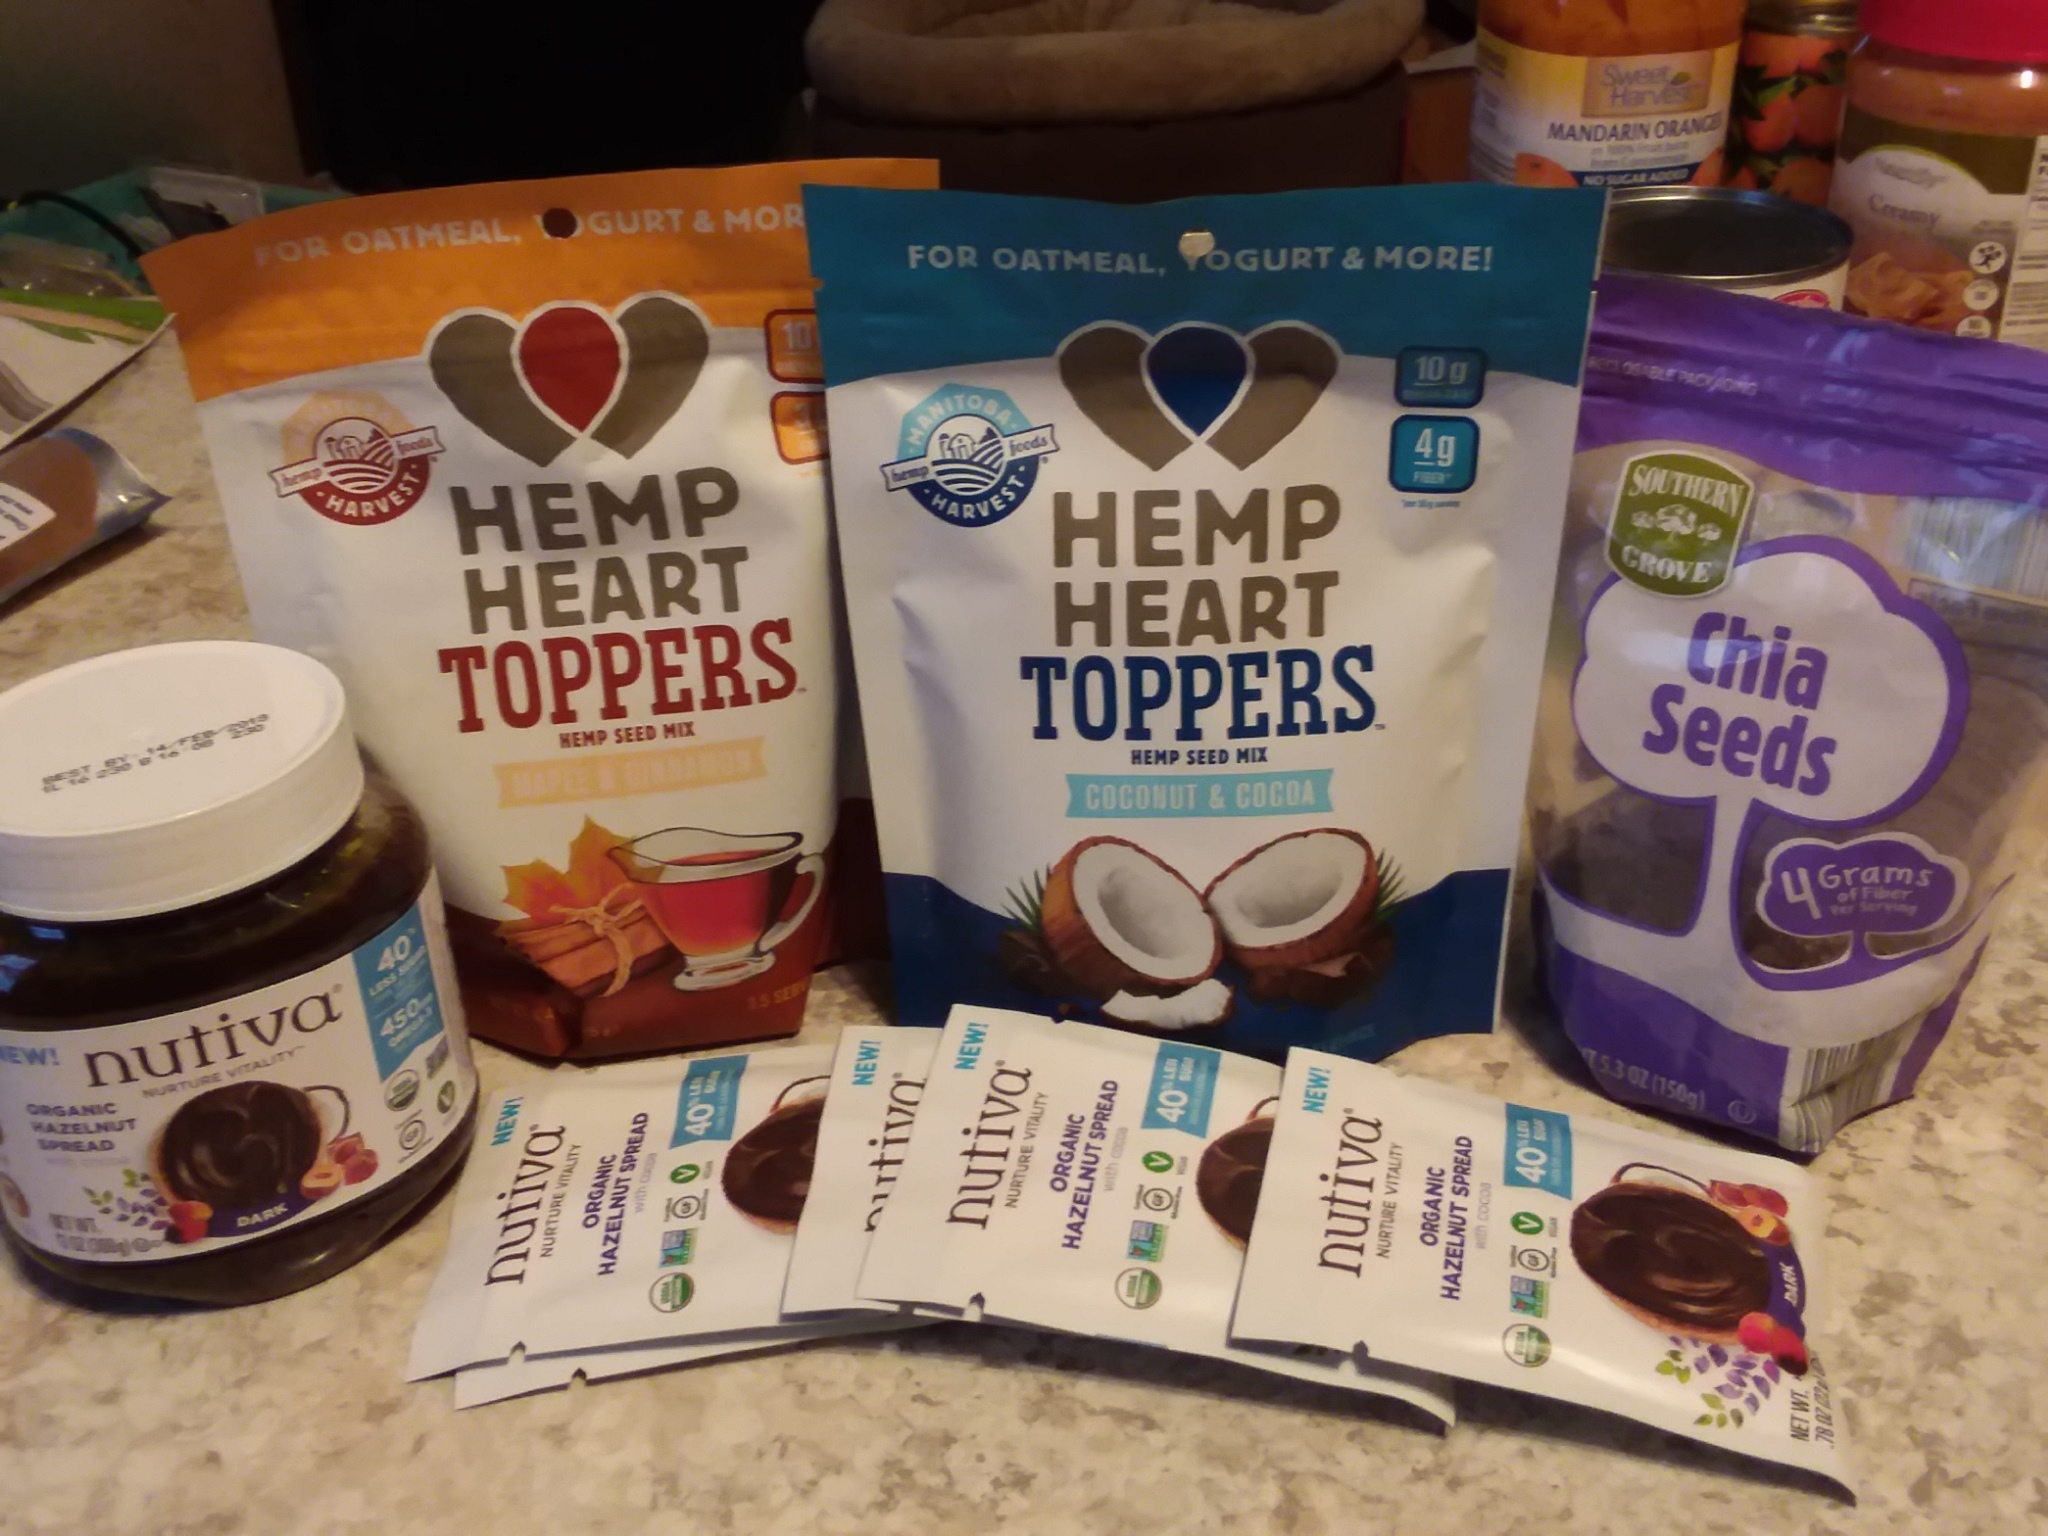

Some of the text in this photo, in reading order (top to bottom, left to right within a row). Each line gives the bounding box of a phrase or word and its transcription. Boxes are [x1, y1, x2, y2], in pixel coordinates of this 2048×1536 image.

[1603, 64, 1671, 86] Sweet
[1610, 83, 1699, 107] Harvest
[1547, 121, 1649, 142] MANDARIN
[255, 236, 331, 267] FOR
[342, 218, 521, 254] OATMEAL,
[693, 210, 716, 234] &
[908, 245, 978, 269] FOR
[992, 247, 1166, 277] OATMEAL,
[1341, 247, 1364, 270] &
[1374, 246, 1493, 271] MORE!
[907, 394, 1014, 446] MANITOBA
[325, 472, 421, 518] HARVEST
[450, 465, 740, 557] HEMP
[931, 475, 1026, 519] HARVEST
[1628, 463, 1746, 519] SOUTHERN
[1053, 483, 1341, 568] HEMP
[1620, 545, 1714, 584] GROVE
[463, 546, 749, 635] HEART
[1054, 571, 1339, 648] HEART
[437, 617, 798, 733] TOPPERS
[1687, 611, 1829, 711] Chia
[1020, 645, 1377, 742] TOPPERS
[559, 721, 696, 749] HEMP SEED MIX
[1131, 747, 1268, 765] HEMP SEED MIX
[1642, 682, 1838, 796] Seeds
[42, 765, 91, 785] BEST
[1086, 780, 1316, 810] COCONUT & COCOA
[1781, 864, 1934, 919] 4 Grams
[1837, 886, 1913, 903] of Fiber
[0, 1045, 61, 1067] NEW!
[85, 1000, 343, 1088] nutiva
[852, 1039, 883, 1086] NEW!
[955, 1021, 990, 1071] NEW!
[142, 1049, 297, 1098] NURTURE VITALITY
[1302, 1066, 1332, 1114] NEW!
[1600, 1055, 1625, 1080] 5.3
[1628, 1065, 1650, 1089] OZ
[1652, 1073, 1706, 1112] (150g)
[26, 1102, 117, 1117] ORGANIC
[31, 1118, 137, 1134] HAZELNUT
[491, 1096, 525, 1147] NEW!
[37, 1139, 116, 1152] SPREAD
[945, 1067, 1033, 1230] nutiva
[1004, 1091, 1050, 1209] NURTURE VITALITY
[1049, 1113, 1085, 1193] ORGANIC
[1062, 1079, 1119, 1250] HAZELNUT SPREAD
[539, 1144, 584, 1258] NURTURE VITALITY
[583, 1154, 618, 1229] ORGANIC
[598, 1111, 650, 1276] HAZELNUT SPREAD
[1104, 1162, 1119, 1192] with
[1317, 1113, 1382, 1278] nutiva
[1375, 1142, 1406, 1260] NURTURE VITALITY
[236, 1202, 289, 1229] DARK
[484, 1124, 566, 1287] nutiva
[1420, 1167, 1446, 1247] ORGANIC
[1439, 1135, 1473, 1301] HAZELNUT SPREAD
[1477, 1218, 1490, 1250] with
[1779, 1261, 1799, 1307] DARK
[1790, 1388, 1810, 1442] NET WT.
[1814, 1406, 1834, 1426] OZ
[1815, 1426, 1835, 1450] .78
